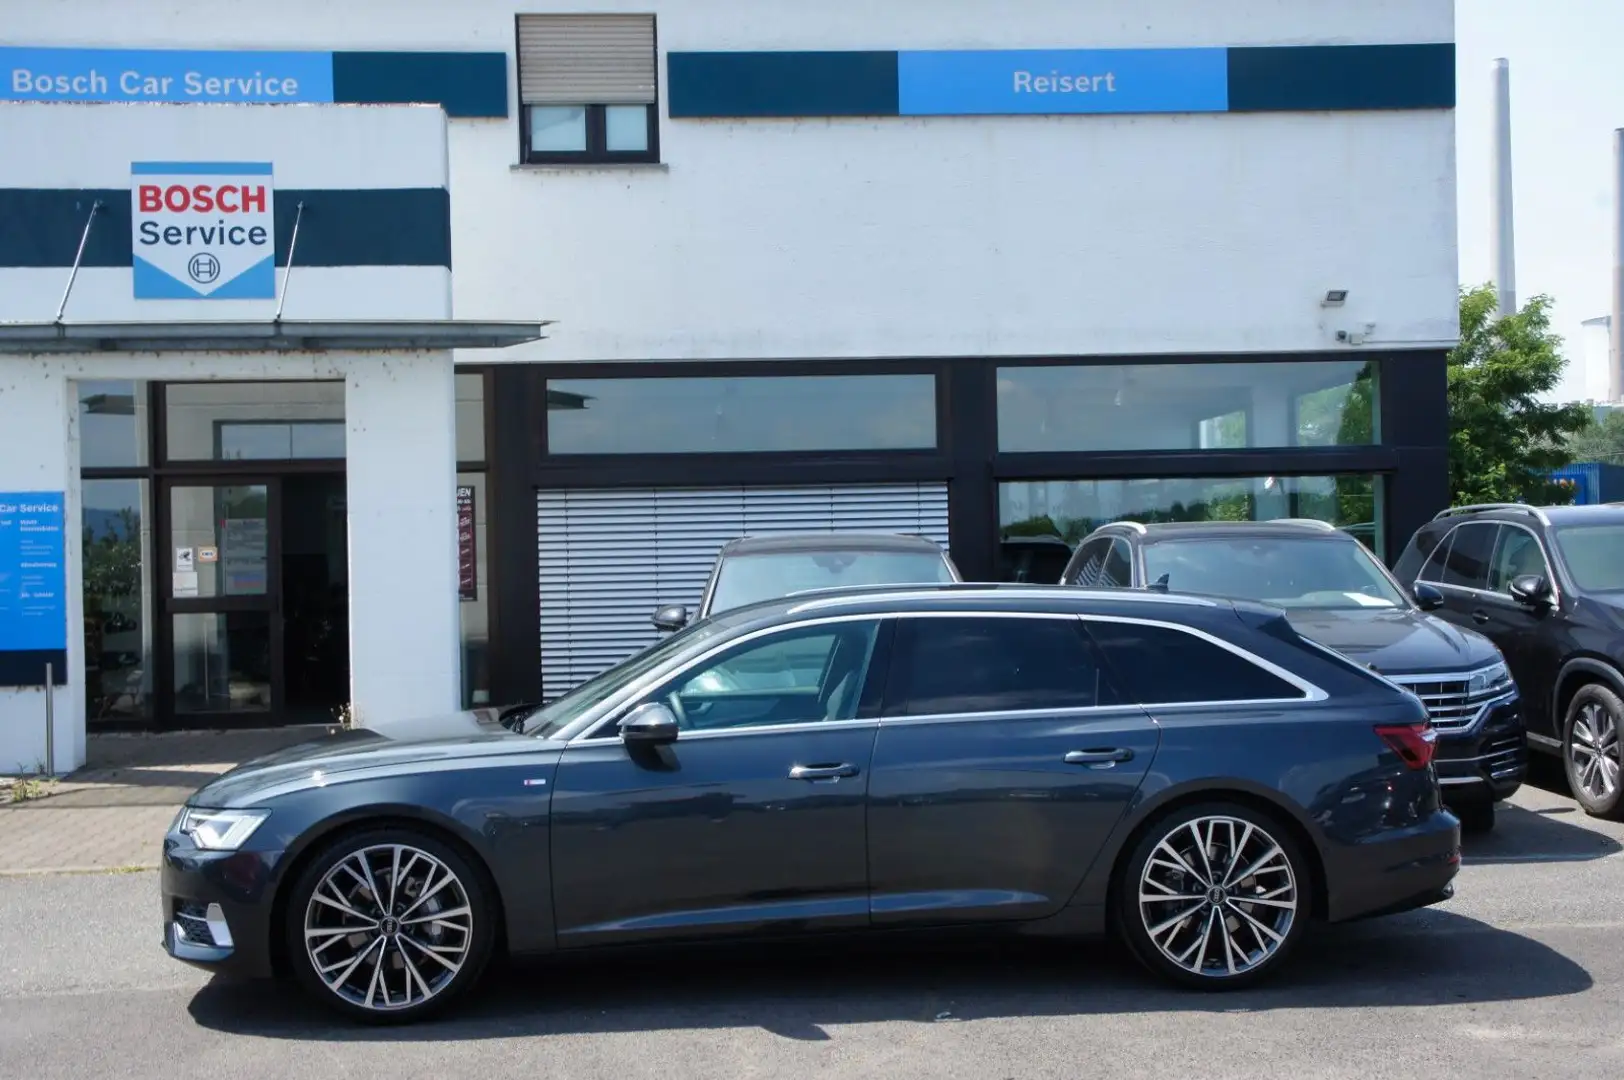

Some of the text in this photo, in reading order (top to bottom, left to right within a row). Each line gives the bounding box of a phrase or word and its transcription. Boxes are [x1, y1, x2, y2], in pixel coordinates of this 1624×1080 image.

[11, 68, 299, 96] Bosch Car Service
[1013, 69, 1117, 93] Reisert
[139, 184, 266, 213] BOSCH
[139, 219, 268, 246] Service
[20, 502, 59, 513] Service
